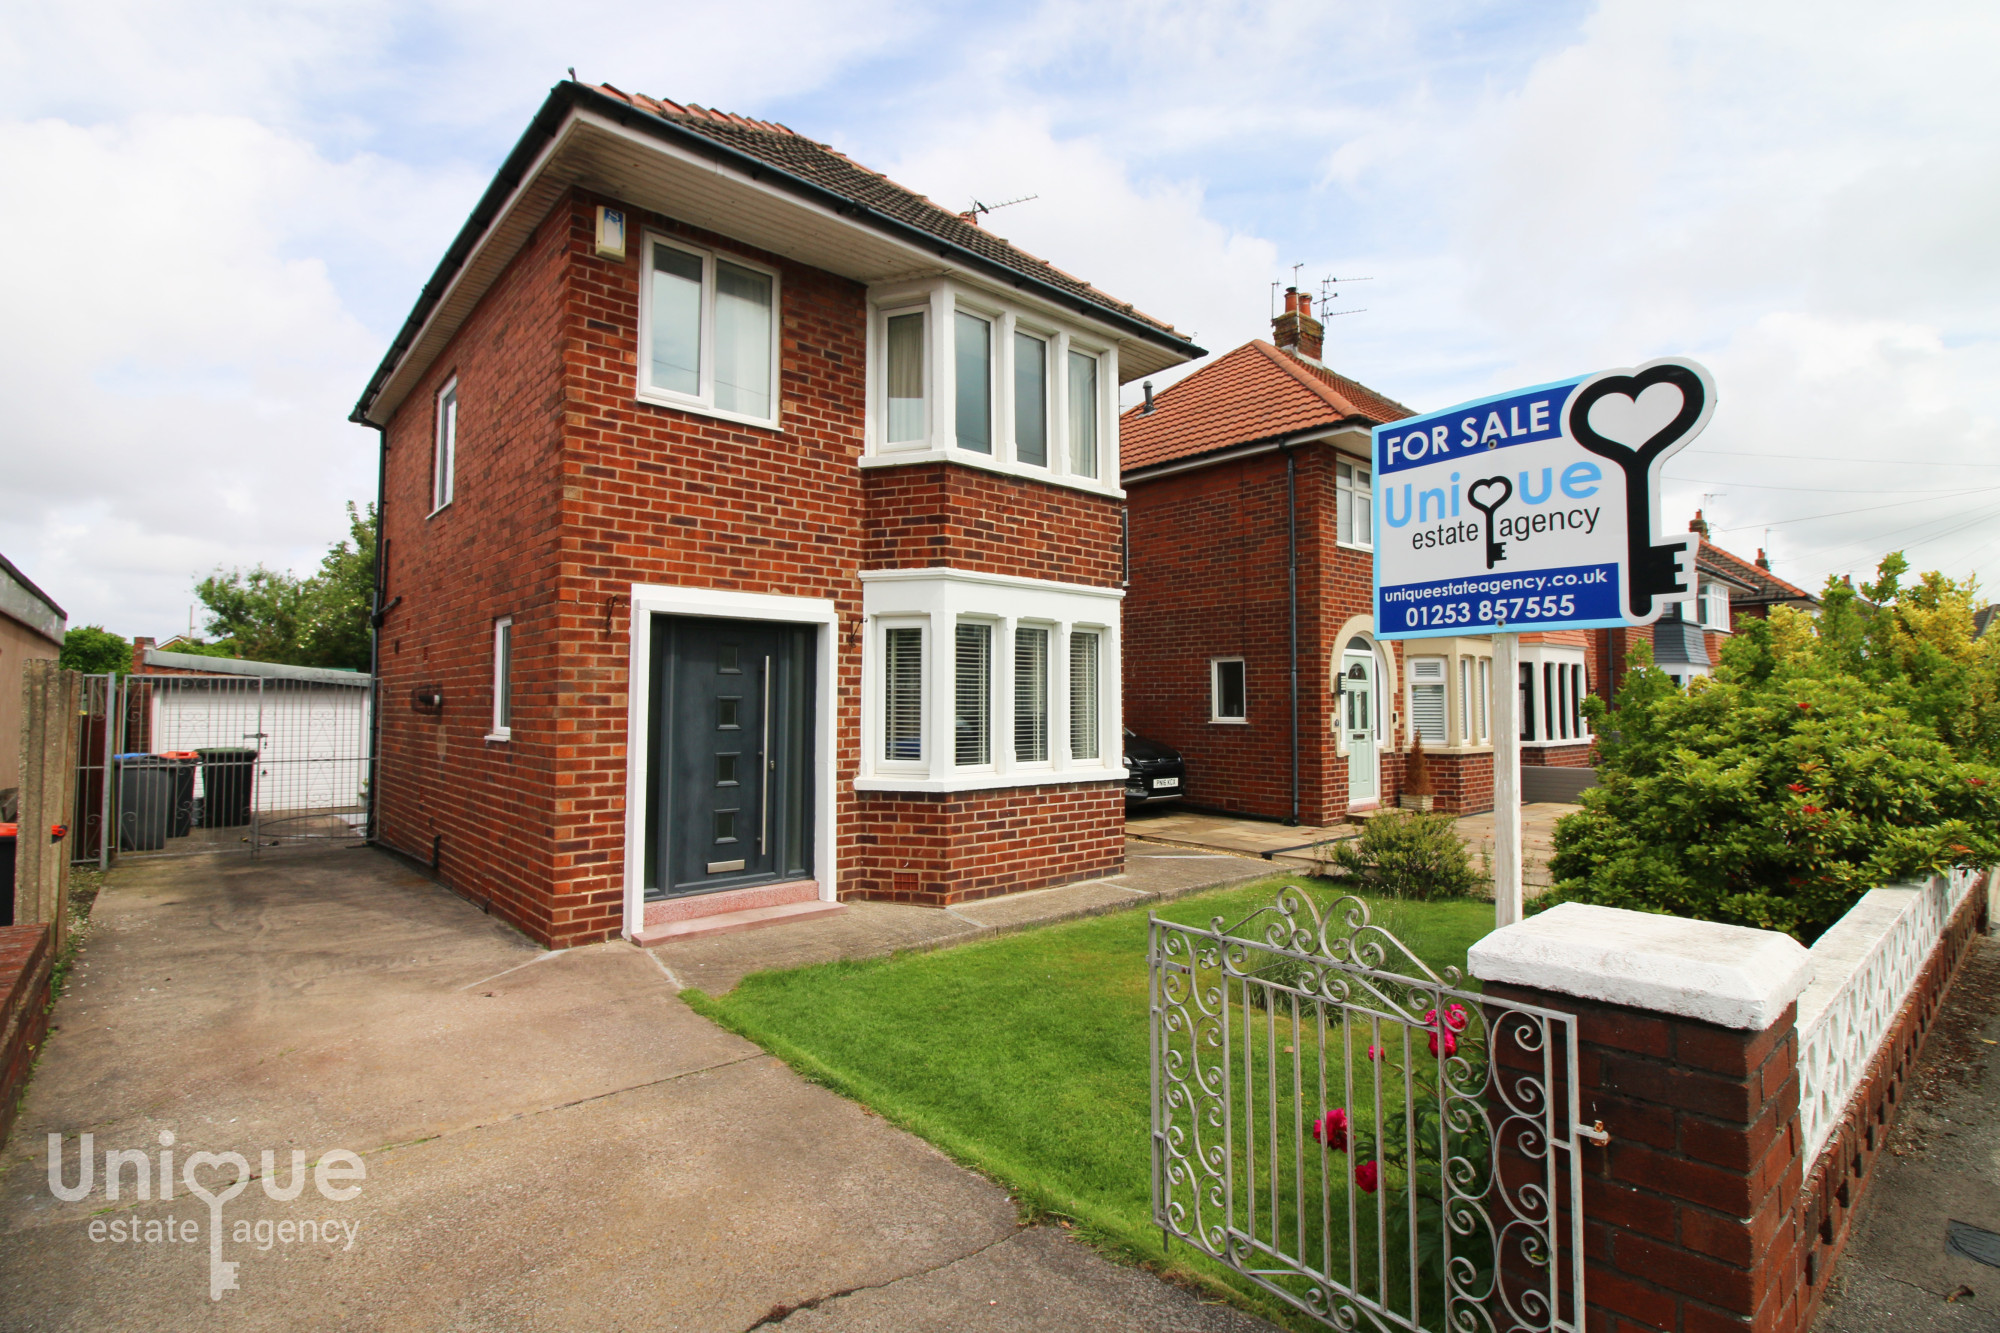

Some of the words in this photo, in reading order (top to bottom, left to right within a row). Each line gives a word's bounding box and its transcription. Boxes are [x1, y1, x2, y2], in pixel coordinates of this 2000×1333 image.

[1387, 425, 1450, 466] FOR
[1460, 400, 1550, 449] SALE
[1385, 461, 1602, 569] Unique
[1412, 520, 1479, 550] estate
[1499, 507, 1600, 541] agency
[1384, 568, 1608, 602] uniqueestateagency.co.uk
[1405, 602, 1471, 627] 01253
[1478, 594, 1575, 621] 857555
